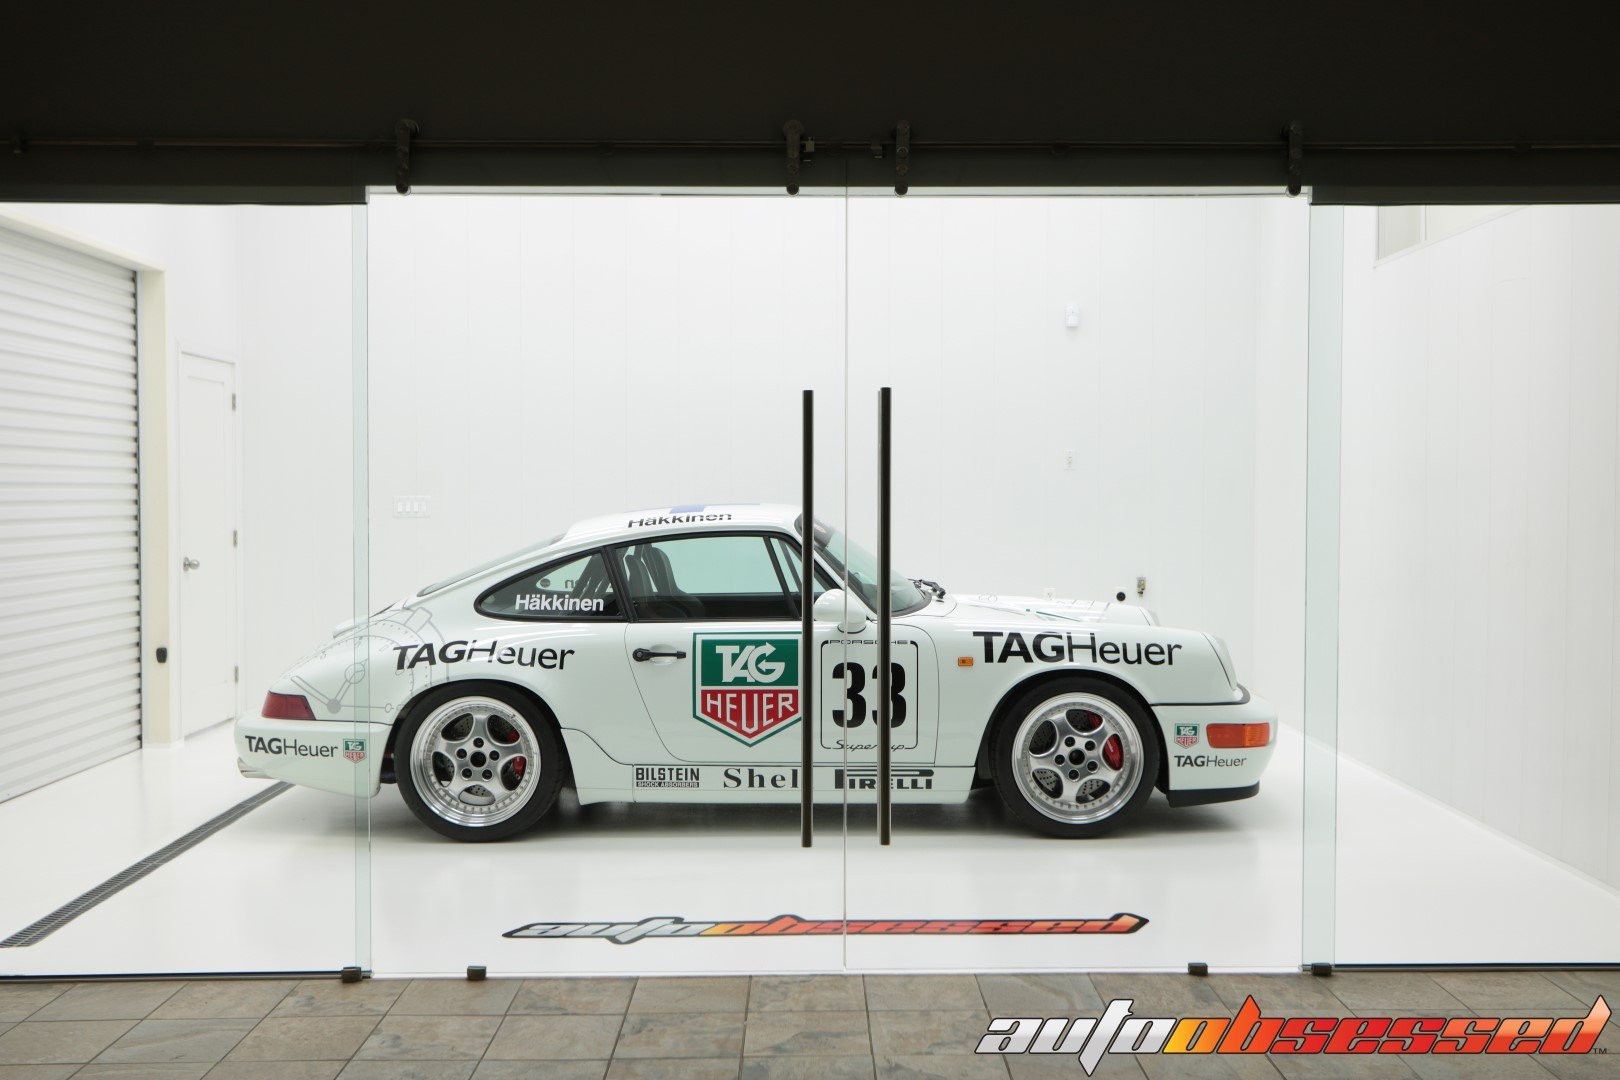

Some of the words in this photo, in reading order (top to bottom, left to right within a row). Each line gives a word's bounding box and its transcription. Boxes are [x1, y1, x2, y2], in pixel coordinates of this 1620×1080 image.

[628, 513, 732, 528] Häkkinen
[515, 594, 604, 611] Häkkinen
[716, 641, 786, 683] TAG
[832, 662, 907, 728] 33
[706, 693, 794, 734] HEUER
[636, 768, 699, 781] BILSTEIN
[723, 768, 799, 789] Shel
